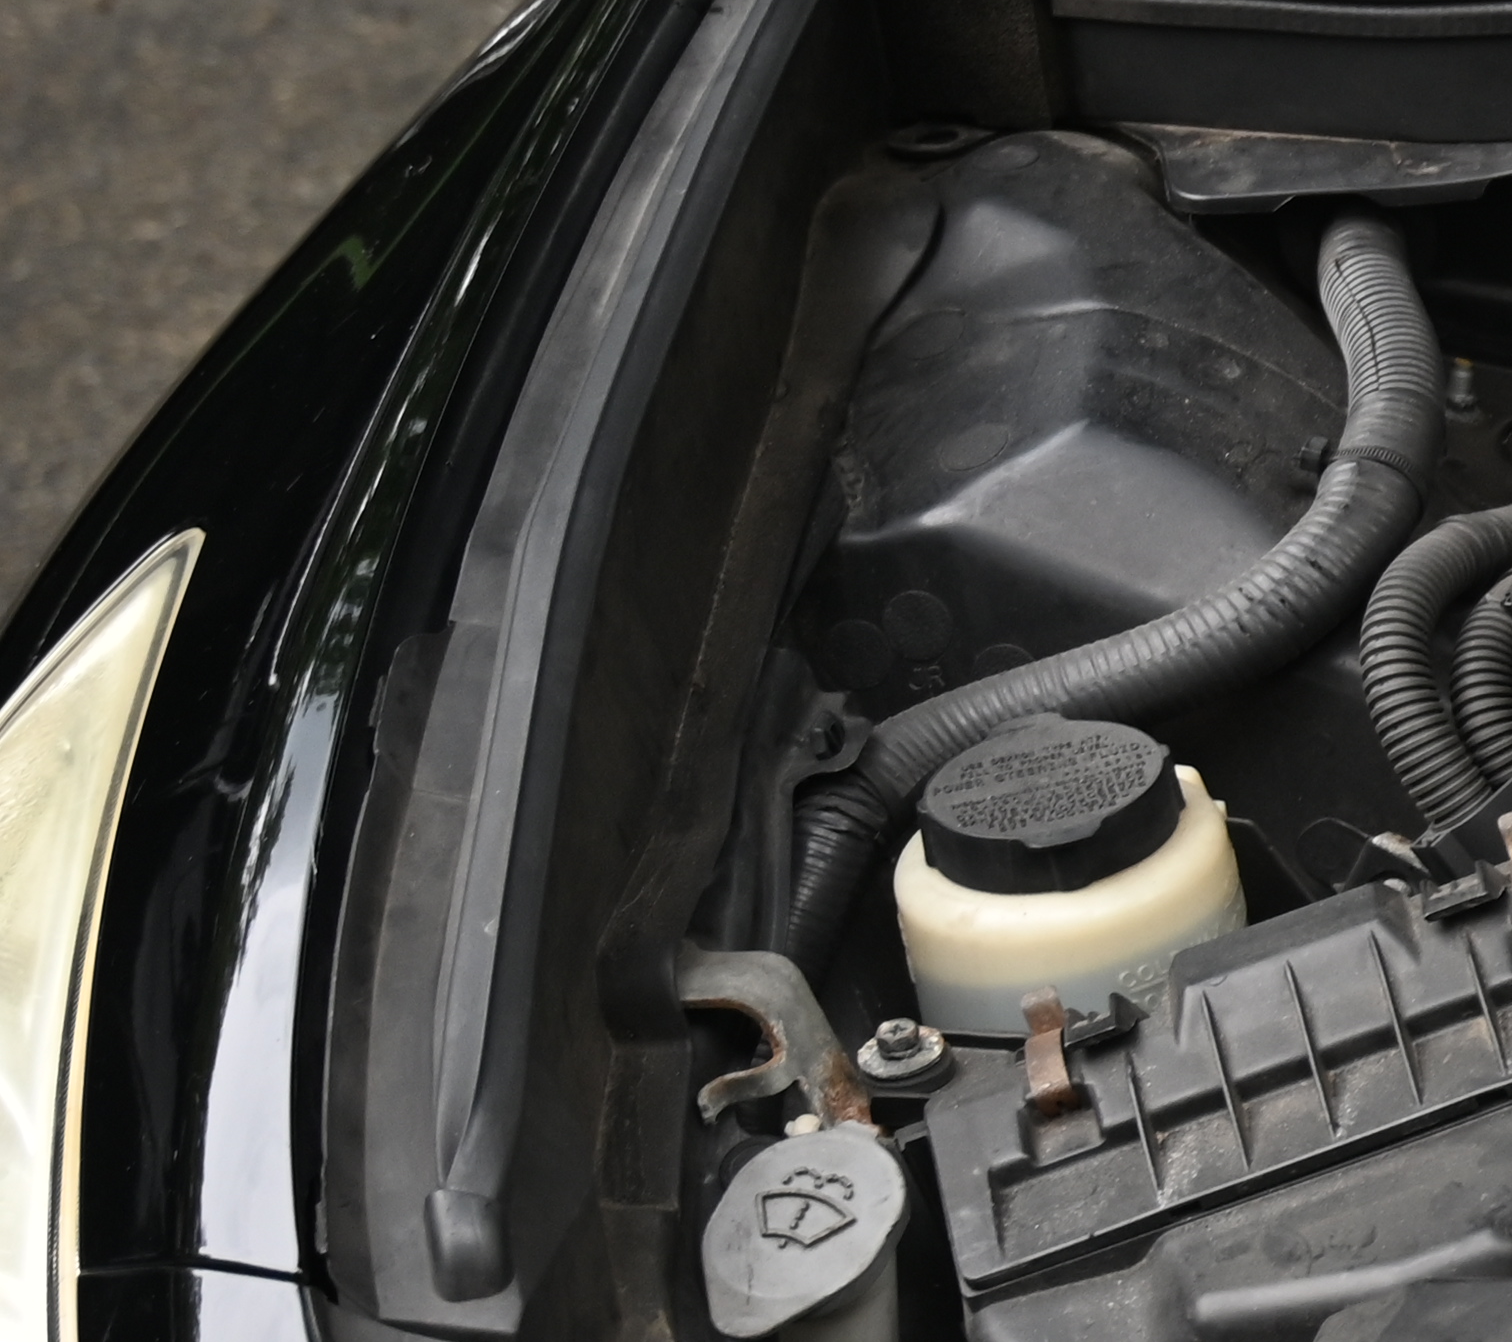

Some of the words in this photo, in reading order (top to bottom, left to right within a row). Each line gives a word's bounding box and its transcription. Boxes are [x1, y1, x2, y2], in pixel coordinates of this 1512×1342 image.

[933, 777, 985, 797] POWER
[995, 758, 1078, 784] STEERING
[960, 769, 990, 780] FILL
